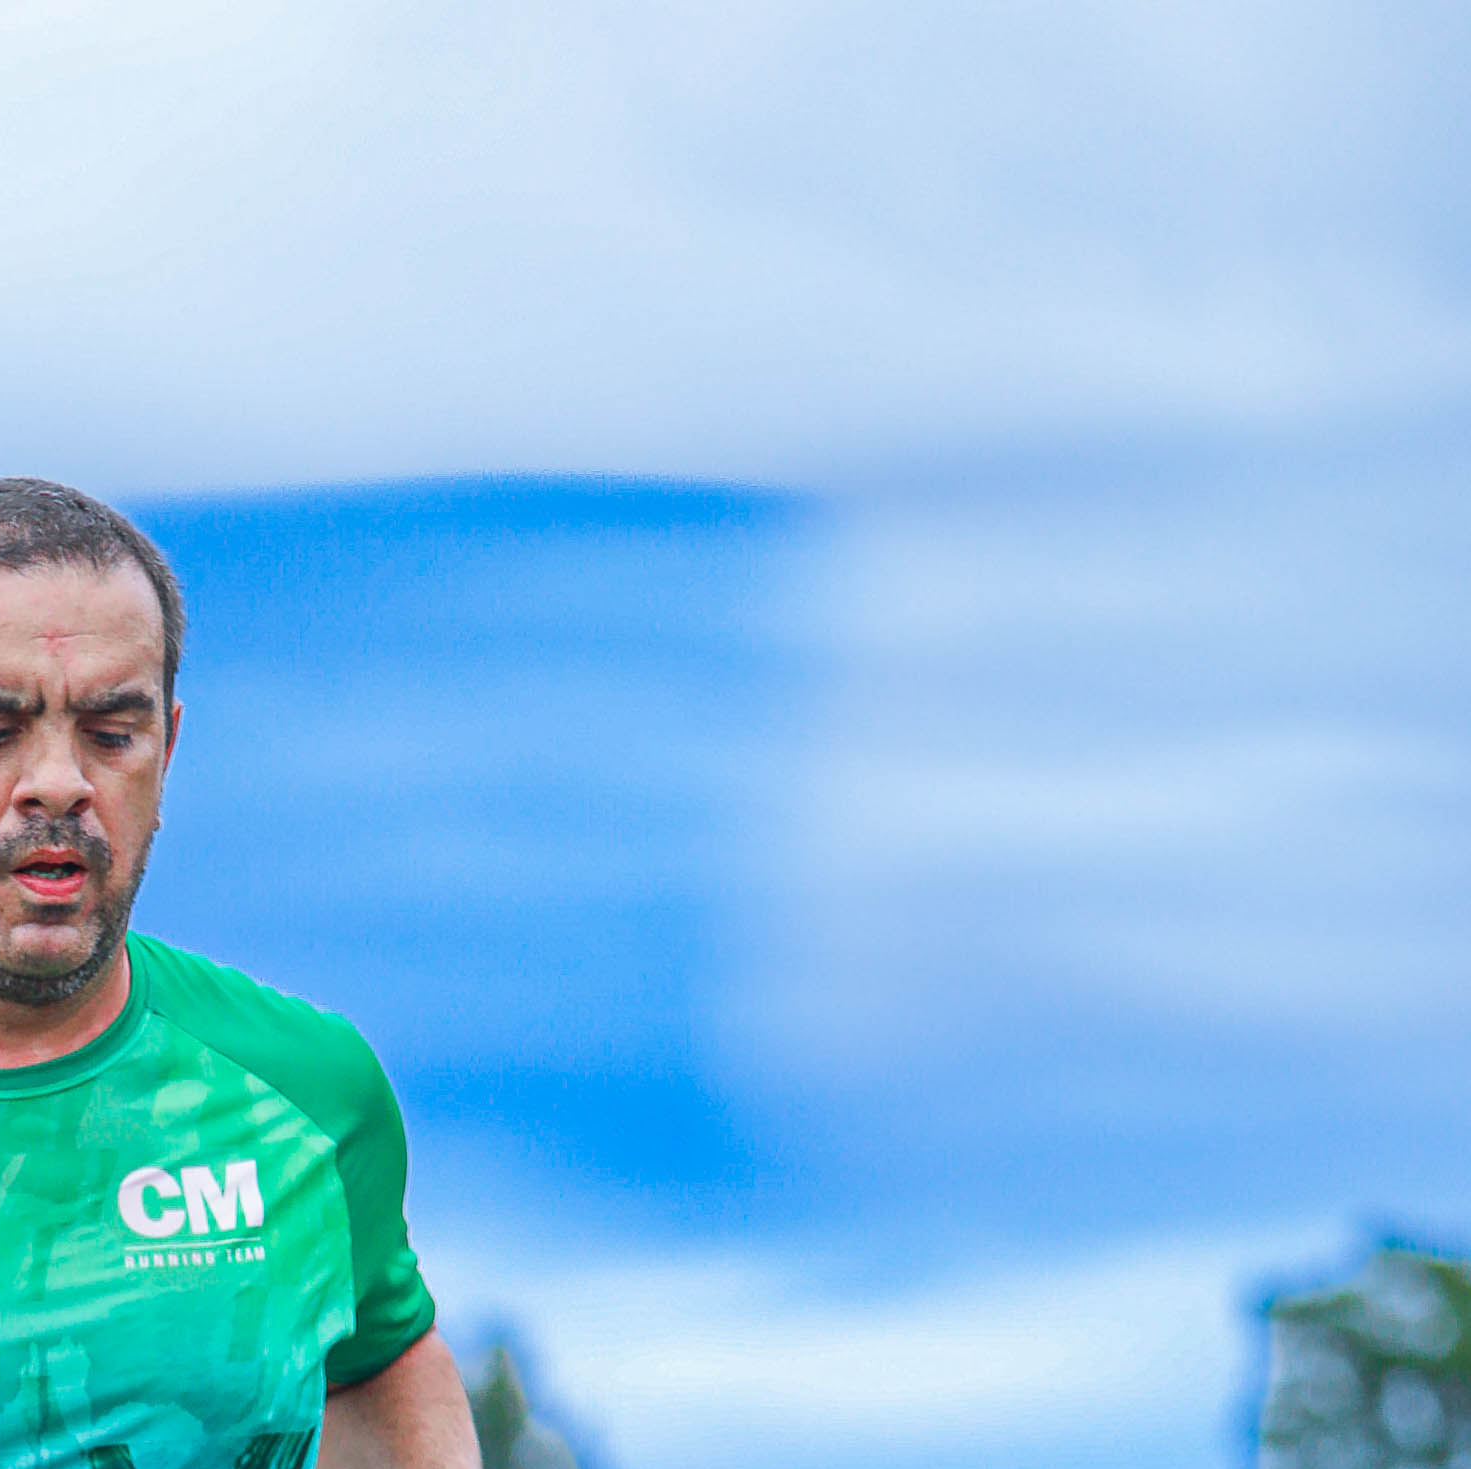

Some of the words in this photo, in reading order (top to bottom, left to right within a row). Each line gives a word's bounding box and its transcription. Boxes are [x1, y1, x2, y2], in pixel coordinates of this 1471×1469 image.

[117, 1160, 264, 1238] CM
[124, 1251, 215, 1269] RUNNING
[225, 1246, 266, 1264] TEAM
